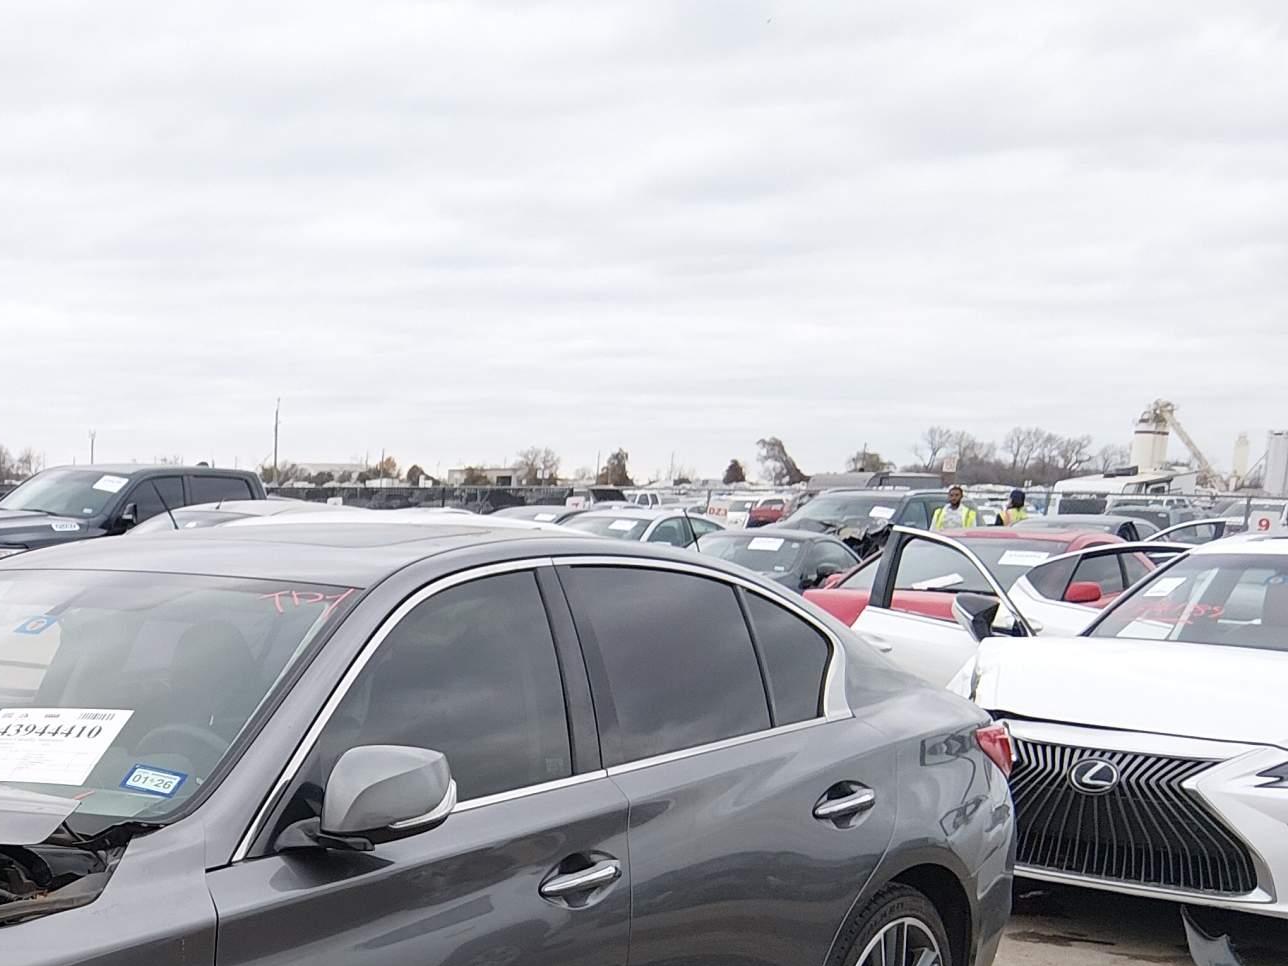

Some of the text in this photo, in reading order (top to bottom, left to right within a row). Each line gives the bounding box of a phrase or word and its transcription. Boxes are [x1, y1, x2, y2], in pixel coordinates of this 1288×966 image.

[1257, 518, 1270, 531] 9
[132, 773, 174, 790] 01 26
